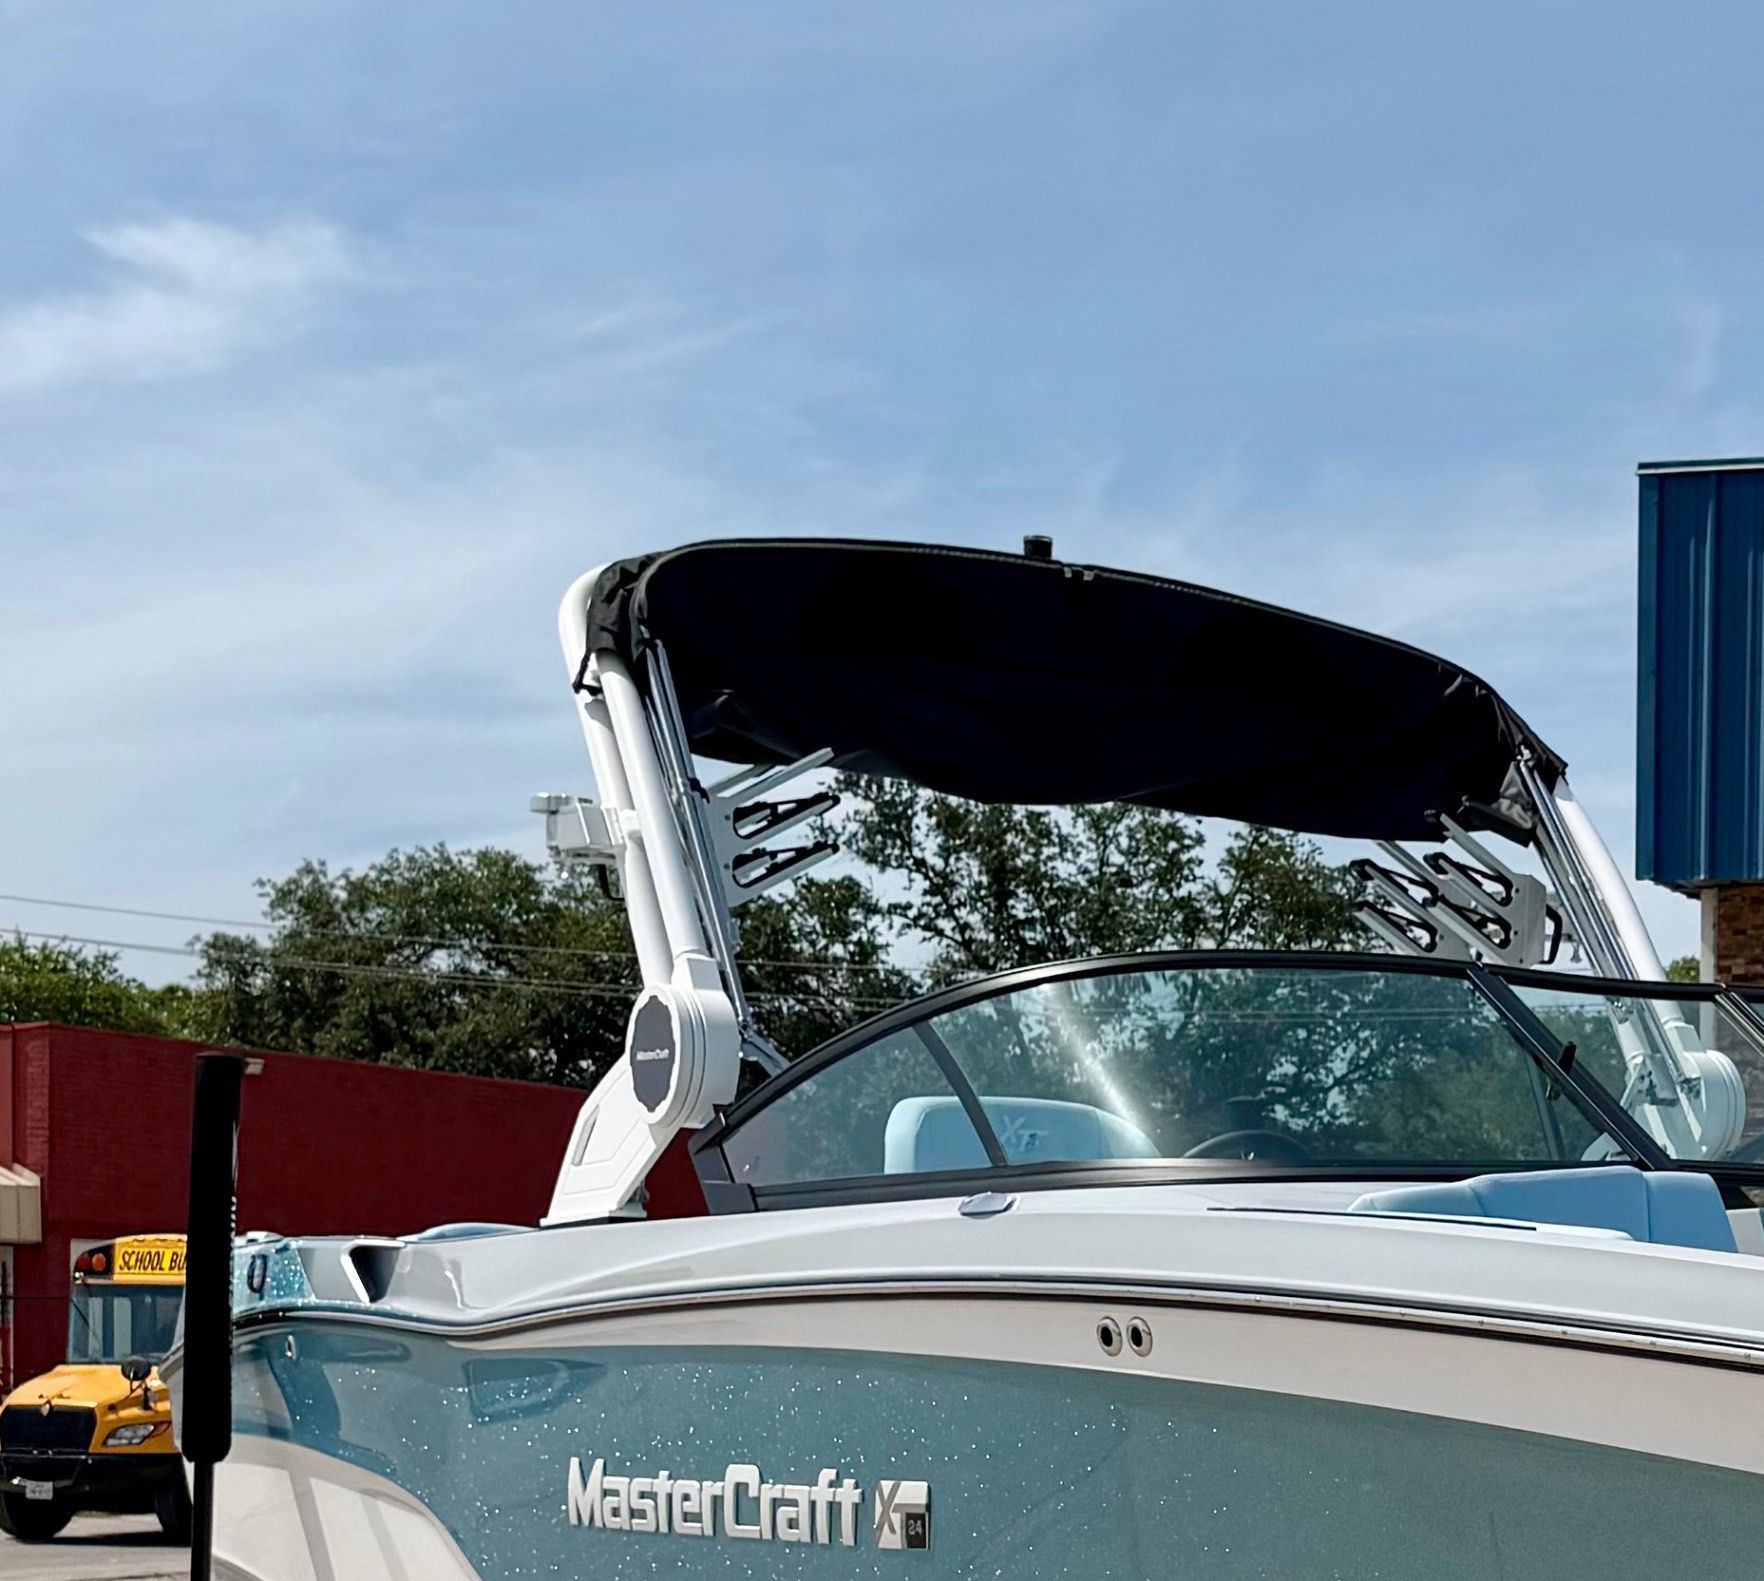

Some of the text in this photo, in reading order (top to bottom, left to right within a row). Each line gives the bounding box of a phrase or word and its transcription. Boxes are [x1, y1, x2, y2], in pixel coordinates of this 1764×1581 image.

[119, 1249, 187, 1271] SCHOOL BU
[567, 1456, 863, 1546] MasterCraft
